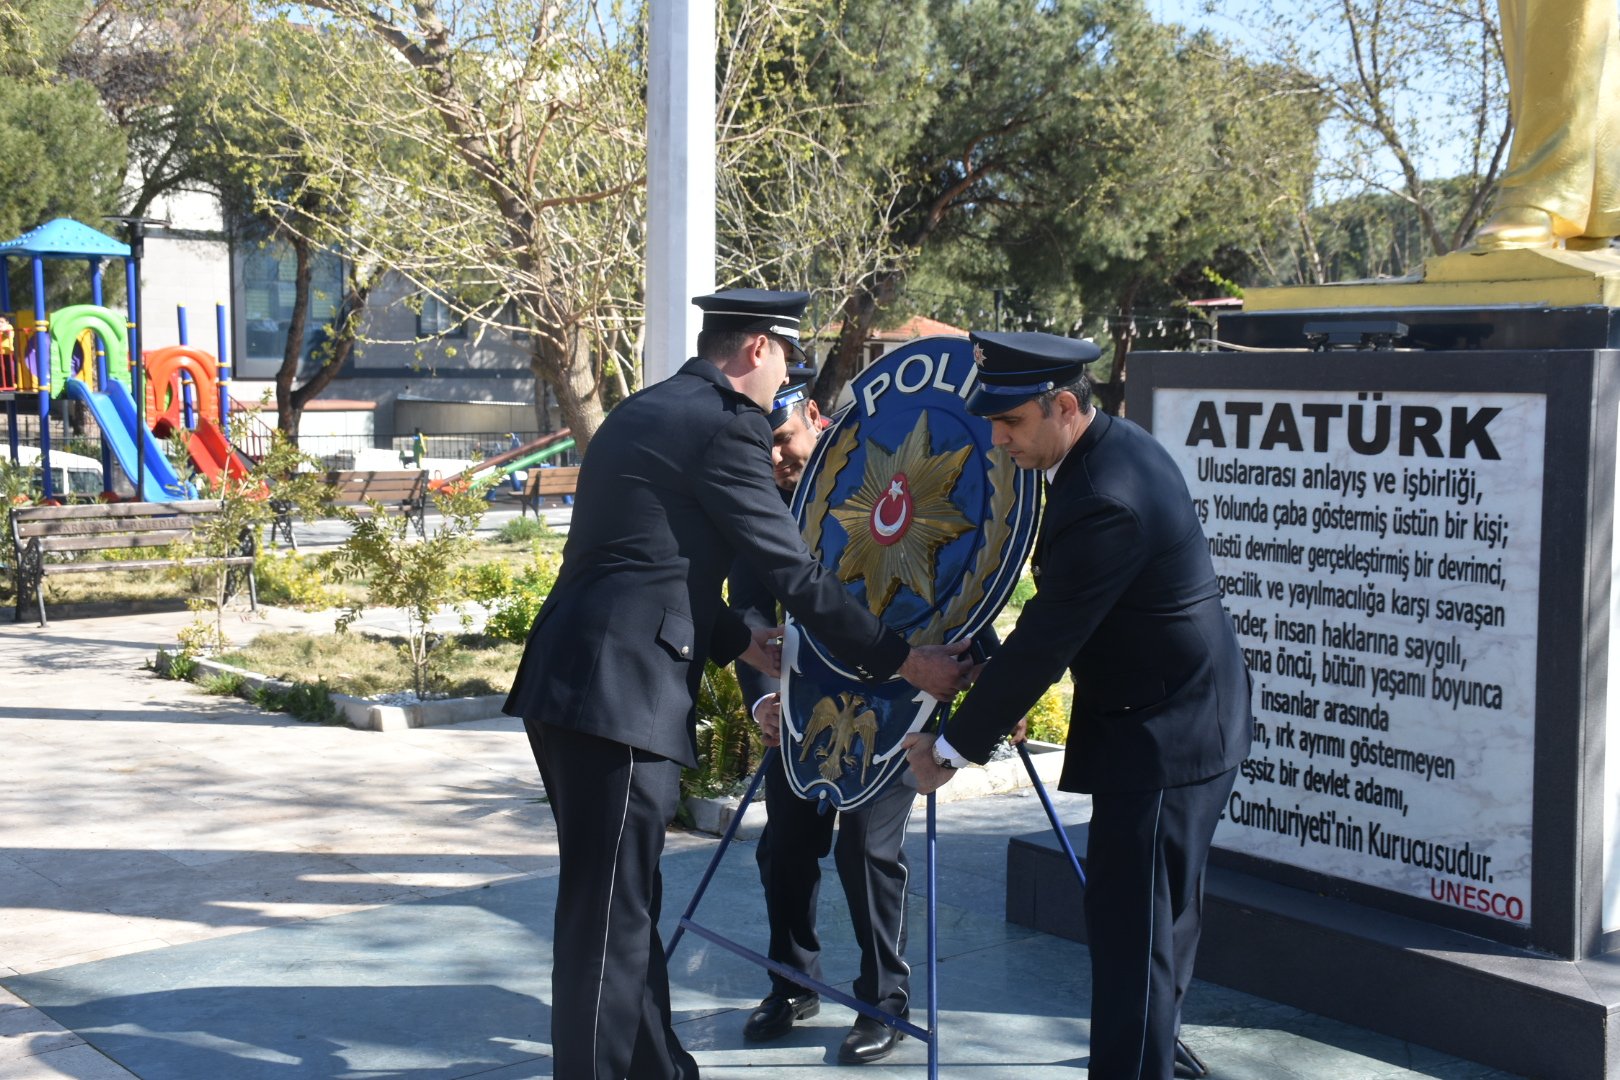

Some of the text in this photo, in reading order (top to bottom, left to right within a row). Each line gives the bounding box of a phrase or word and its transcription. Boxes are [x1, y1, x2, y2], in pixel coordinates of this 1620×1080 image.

[1185, 392, 1502, 461] ATATÜRK
[1197, 456, 1483, 505] Uluslararası anlayış ve işbirliği,
[1213, 494, 1268, 523] Yolunda
[1273, 499, 1307, 531] çaba
[1312, 502, 1387, 539] göstermiş
[1393, 507, 1438, 537] üstün
[1445, 510, 1468, 540] bir
[1473, 512, 1508, 549] kişi;
[1207, 532, 1506, 591] nüstü devrimler gerçekleştirmiş bir devrimci,
[1216, 571, 1505, 631] gecilik ve yayılmacılığa karşı savaşan
[1274, 613, 1316, 645] insan
[1322, 619, 1398, 656] haklarına
[1404, 635, 1467, 672] saygılı,
[1241, 646, 1503, 711] sına öncü, bütün yaşamı boyunca
[1261, 683, 1389, 732] insanlar arasında
[1253, 716, 1455, 782] in, ırk ayrımı göstermeyen
[1240, 756, 1409, 817] eşsiz bir devlet adamı,
[1229, 790, 1493, 884] Cumhuriyeti'nin Kurucusudur.
[1430, 877, 1523, 921] UNESCO
